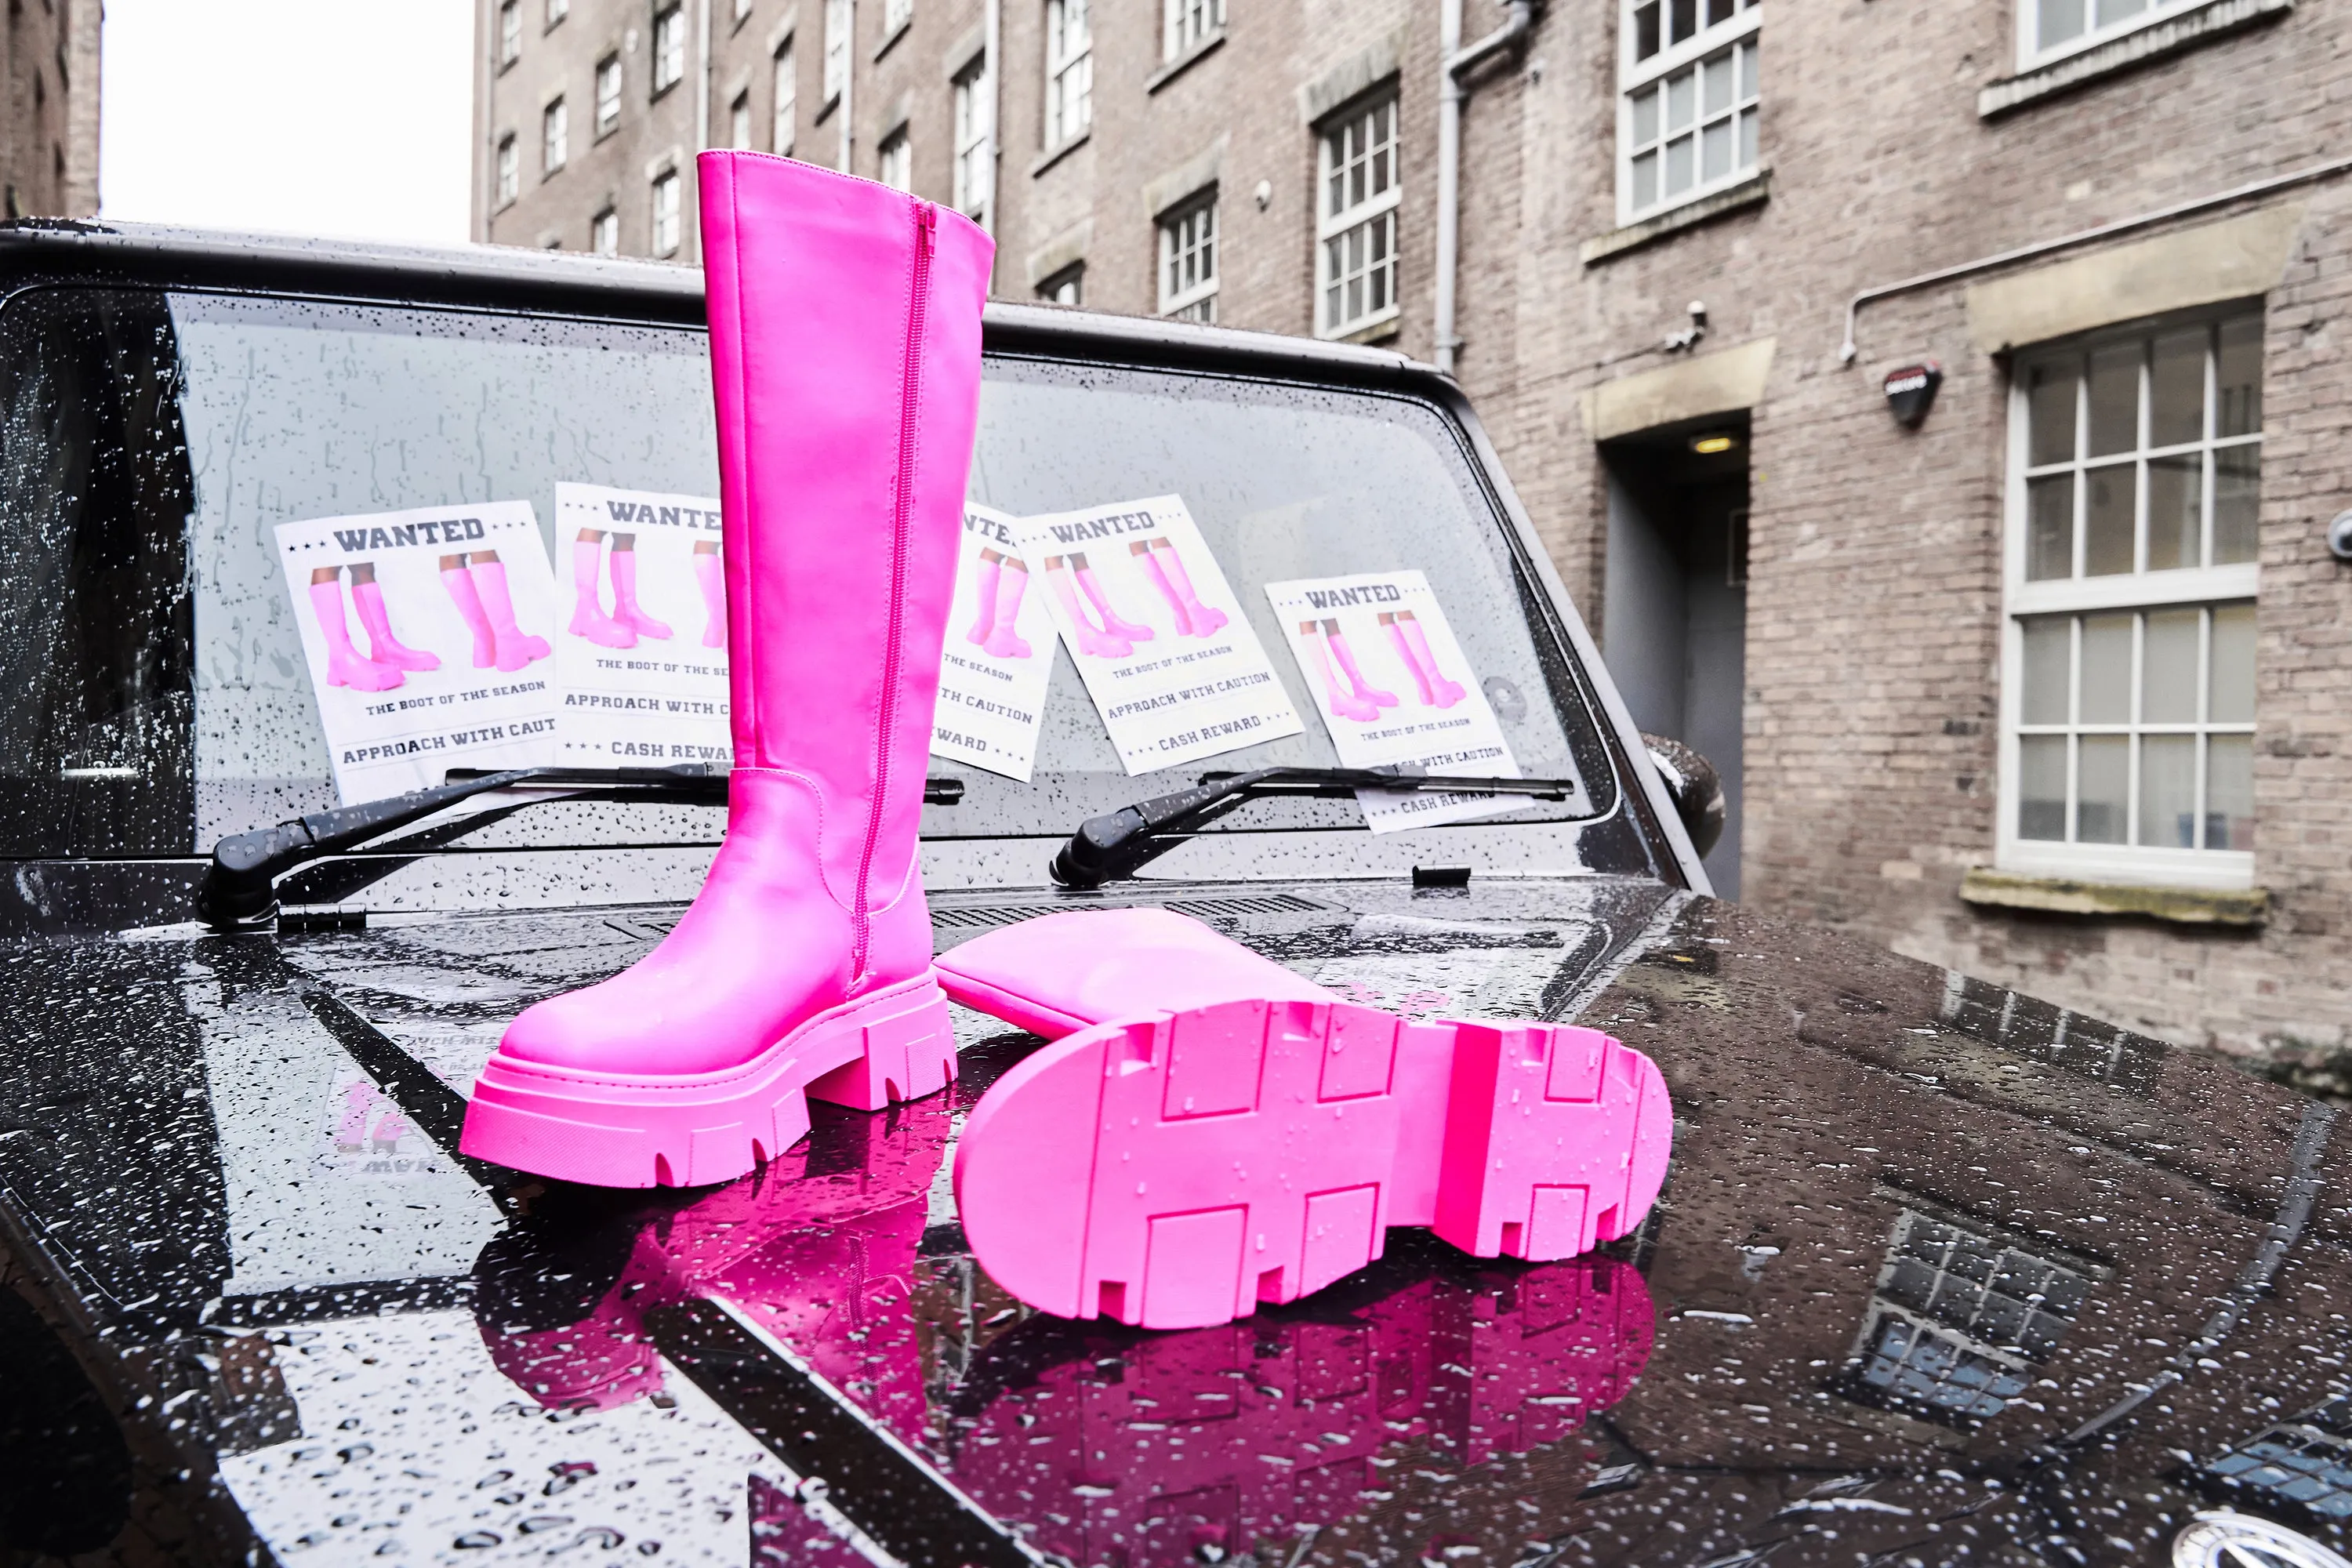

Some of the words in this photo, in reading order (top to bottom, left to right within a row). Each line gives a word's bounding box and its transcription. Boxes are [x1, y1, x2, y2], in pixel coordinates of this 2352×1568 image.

[607, 500, 722, 531] WANTE
[964, 513, 1017, 548] NTE
[1050, 511, 1155, 543] WANTED
[333, 518, 485, 551] WANTED
[1305, 585, 1401, 608] WANTED
[597, 659, 622, 669] THE
[627, 661, 659, 671] BOOT
[664, 663, 679, 673] OF
[684, 666, 709, 675] THE
[944, 653, 966, 666] THE
[969, 662, 1013, 682] SEASON
[1112, 667, 1134, 679] THE
[1136, 662, 1159, 673] BOOT
[1161, 659, 1174, 667] OF
[1176, 653, 1196, 664] THE
[1197, 645, 1233, 659] SEASON
[366, 703, 395, 716] THE
[400, 697, 434, 710] BOOT
[439, 694, 455, 704] OF
[460, 689, 488, 702] THE
[493, 681, 546, 696] SEASON
[565, 694, 659, 710] APPROACH
[666, 701, 713, 714] WITH
[937, 686, 961, 702] TH
[966, 695, 1033, 724] CAUTION
[1108, 694, 1177, 719] APPROACH
[1179, 684, 1215, 701] WITH
[1217, 672, 1271, 691] CAUTION
[343, 737, 446, 764] APPROACH
[451, 726, 504, 746] WITH
[510, 719, 556, 736] CAUT
[931, 727, 987, 752] WARD
[1159, 731, 1199, 751] CASH
[1201, 716, 1261, 740] REWARD
[1361, 732, 1379, 742] THE
[1418, 723, 1436, 732] THE
[612, 742, 664, 757] CASH
[671, 745, 735, 760] REWA
[1420, 753, 1454, 768] WITH
[1455, 746, 1504, 762] CAUTION
[1401, 797, 1437, 814] CASH
